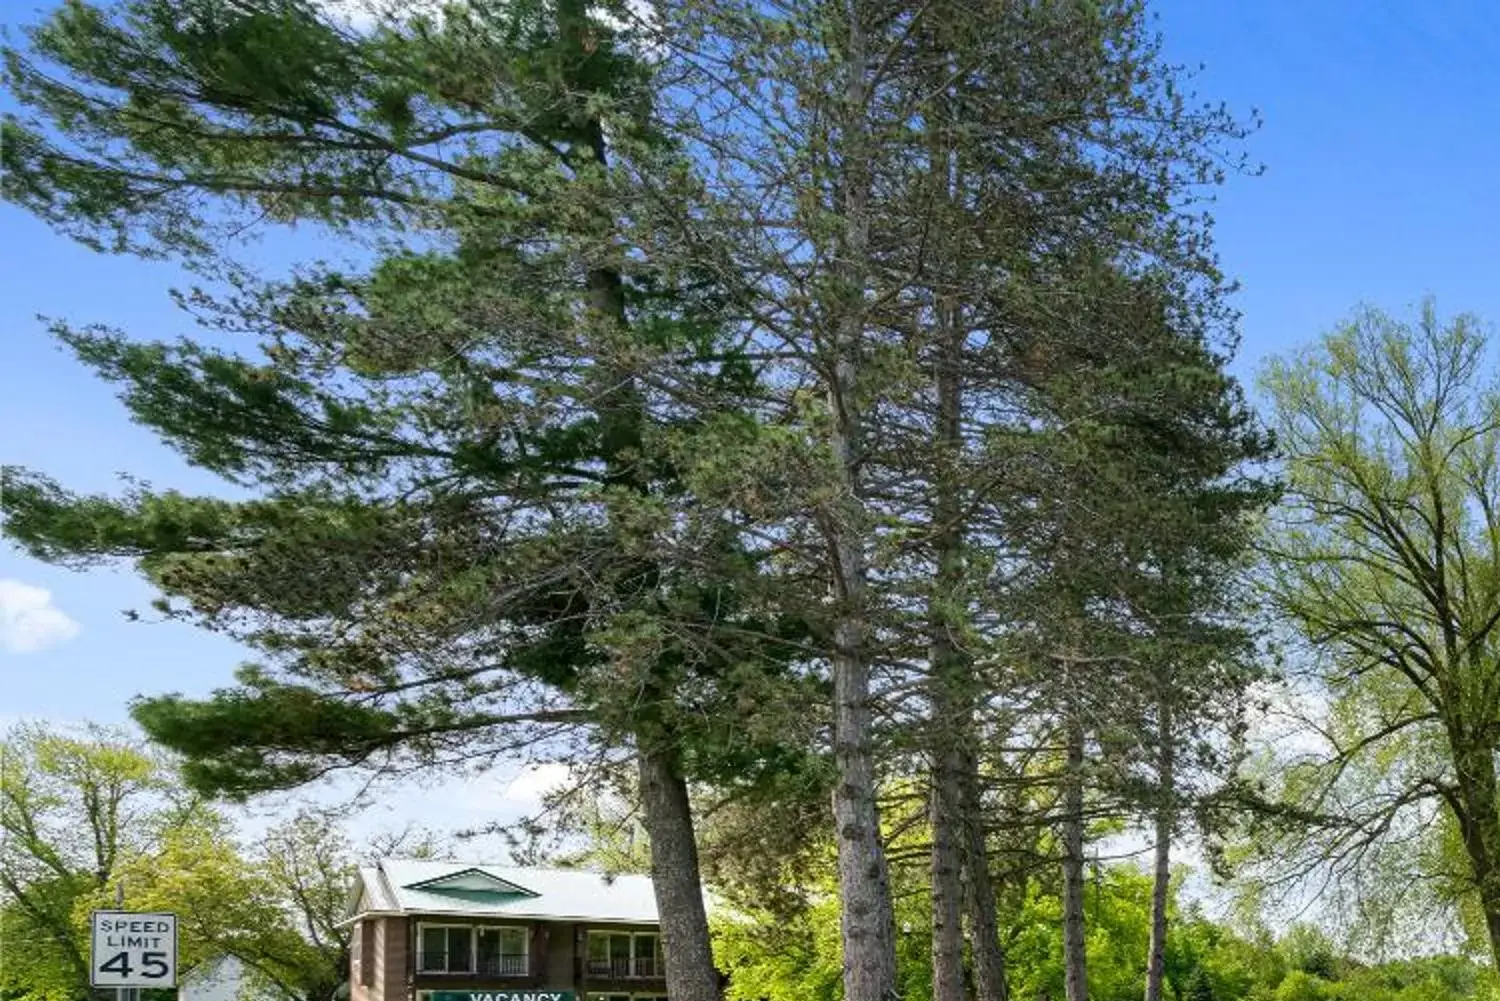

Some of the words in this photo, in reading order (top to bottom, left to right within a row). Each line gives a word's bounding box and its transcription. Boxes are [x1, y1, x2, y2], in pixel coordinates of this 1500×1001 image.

[100, 920, 169, 932] SPEED
[107, 935, 162, 948] LIMIT
[99, 952, 168, 978] 45
